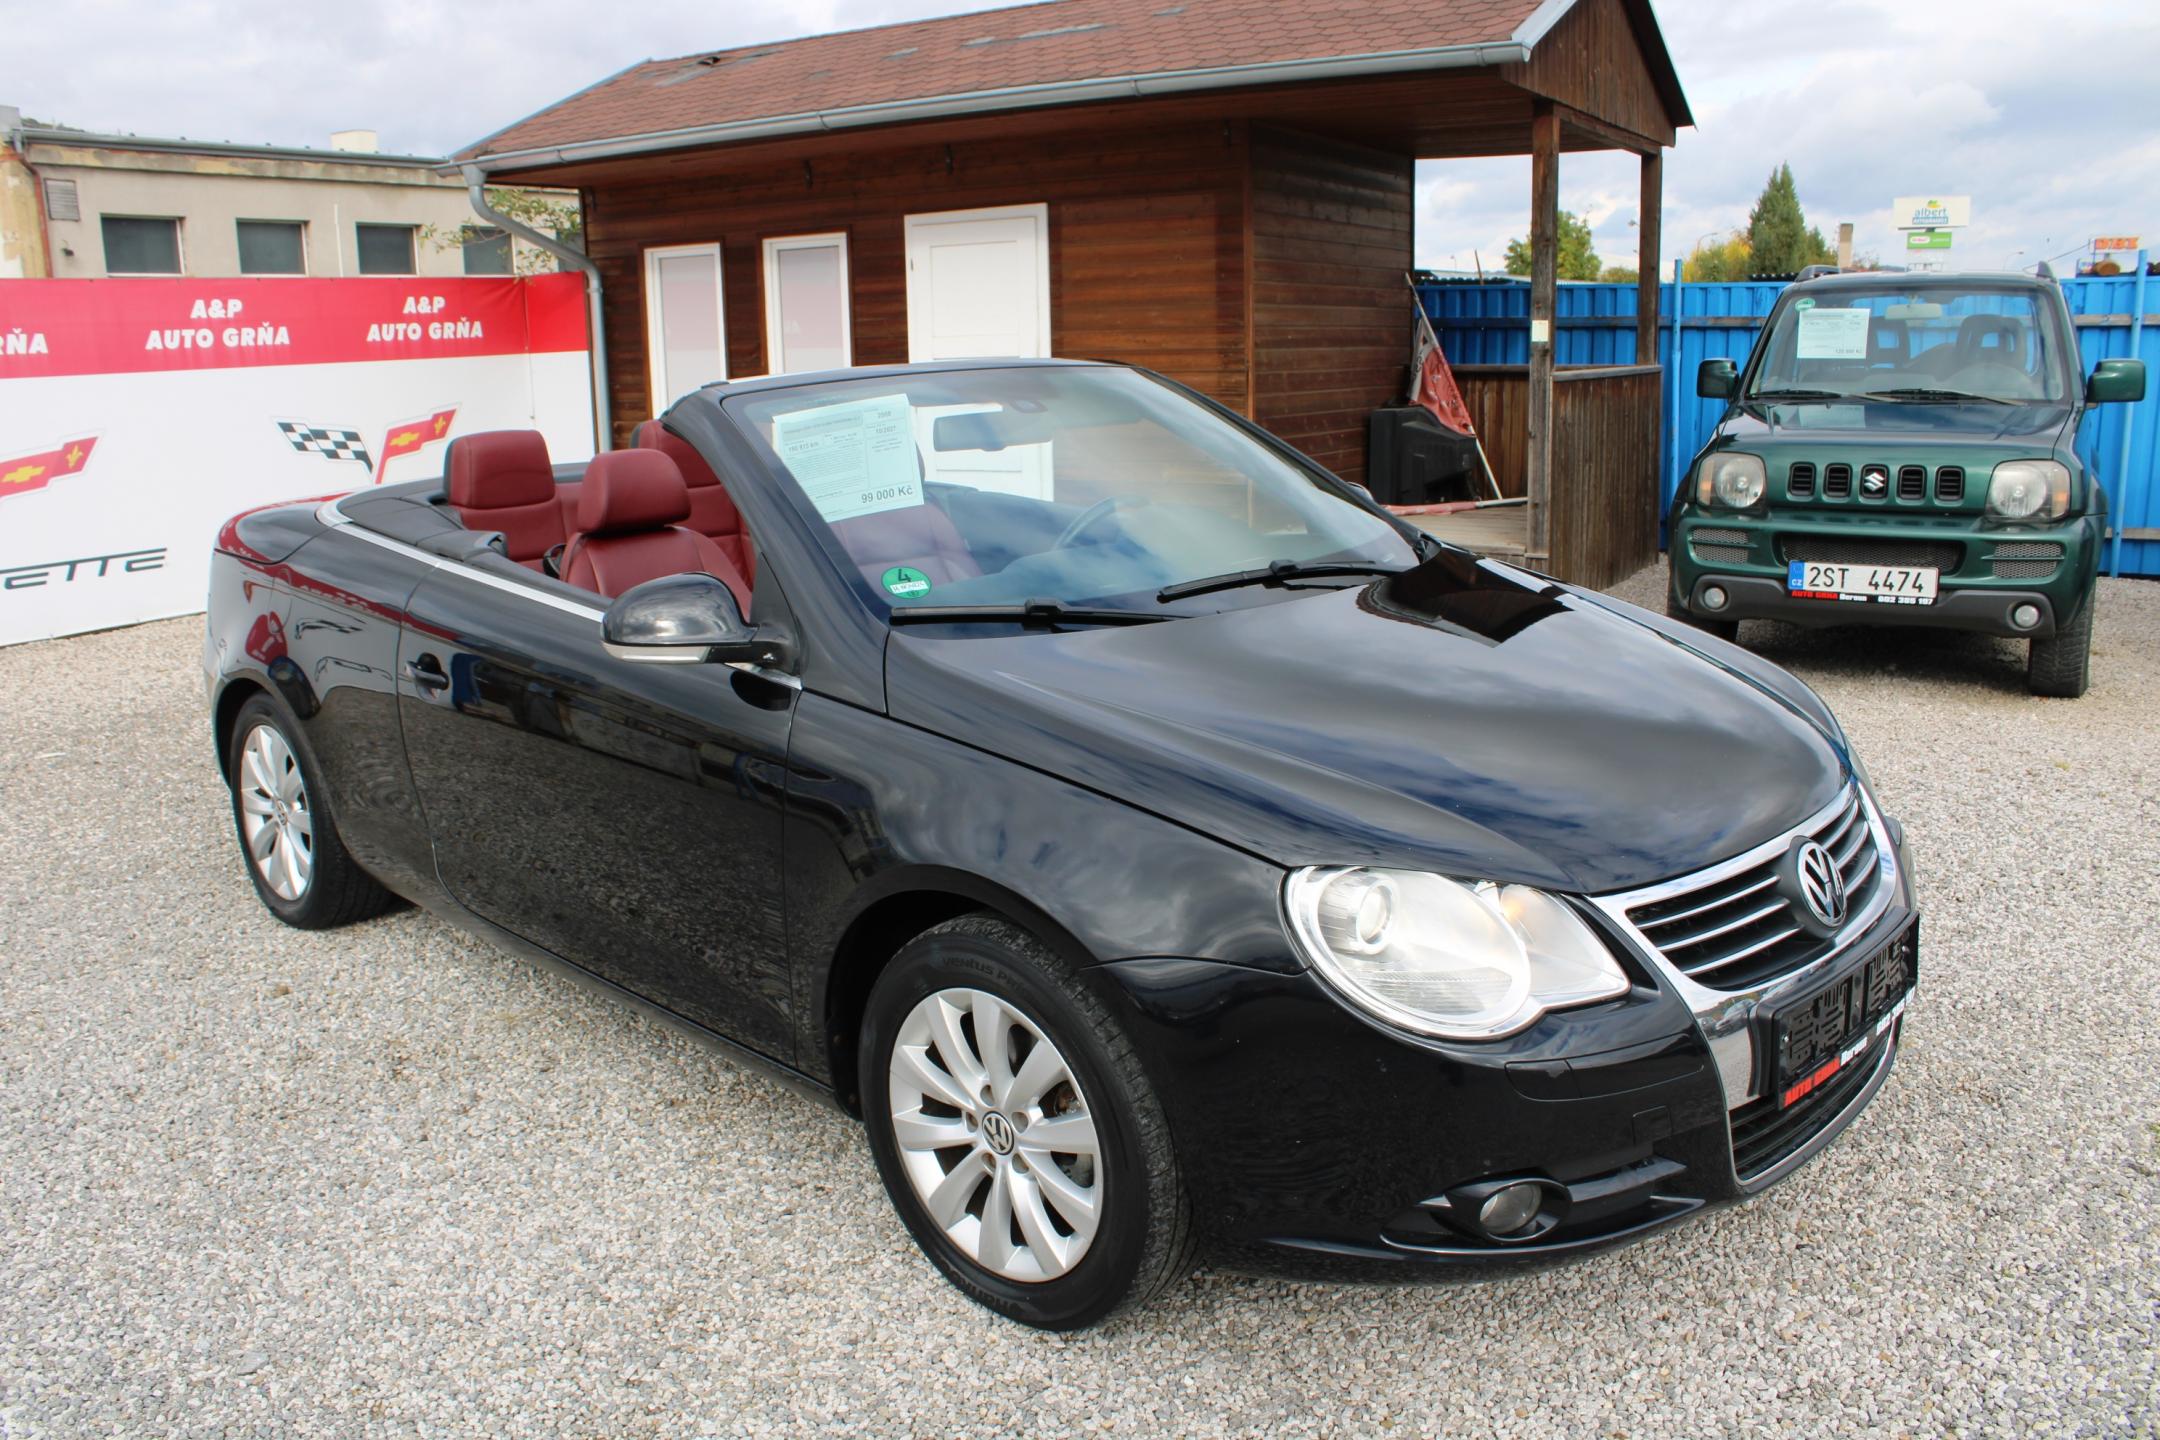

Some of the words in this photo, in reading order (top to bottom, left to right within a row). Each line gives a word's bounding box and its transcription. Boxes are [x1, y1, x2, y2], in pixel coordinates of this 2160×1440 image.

[190, 298, 243, 319] A&P
[403, 295, 446, 315] A&P
[145, 328, 215, 350] AUTO
[222, 321, 290, 348] GRŇA
[366, 322, 422, 342] AUTO
[428, 316, 483, 340] GRŇA
[0, 327, 49, 355] ŇA
[861, 492, 874, 504] 99
[876, 488, 895, 501] 000
[898, 485, 913, 497] Kč
[898, 568, 912, 582] 4
[1808, 566, 1849, 589] 2ST
[1868, 570, 1925, 593] 4474
